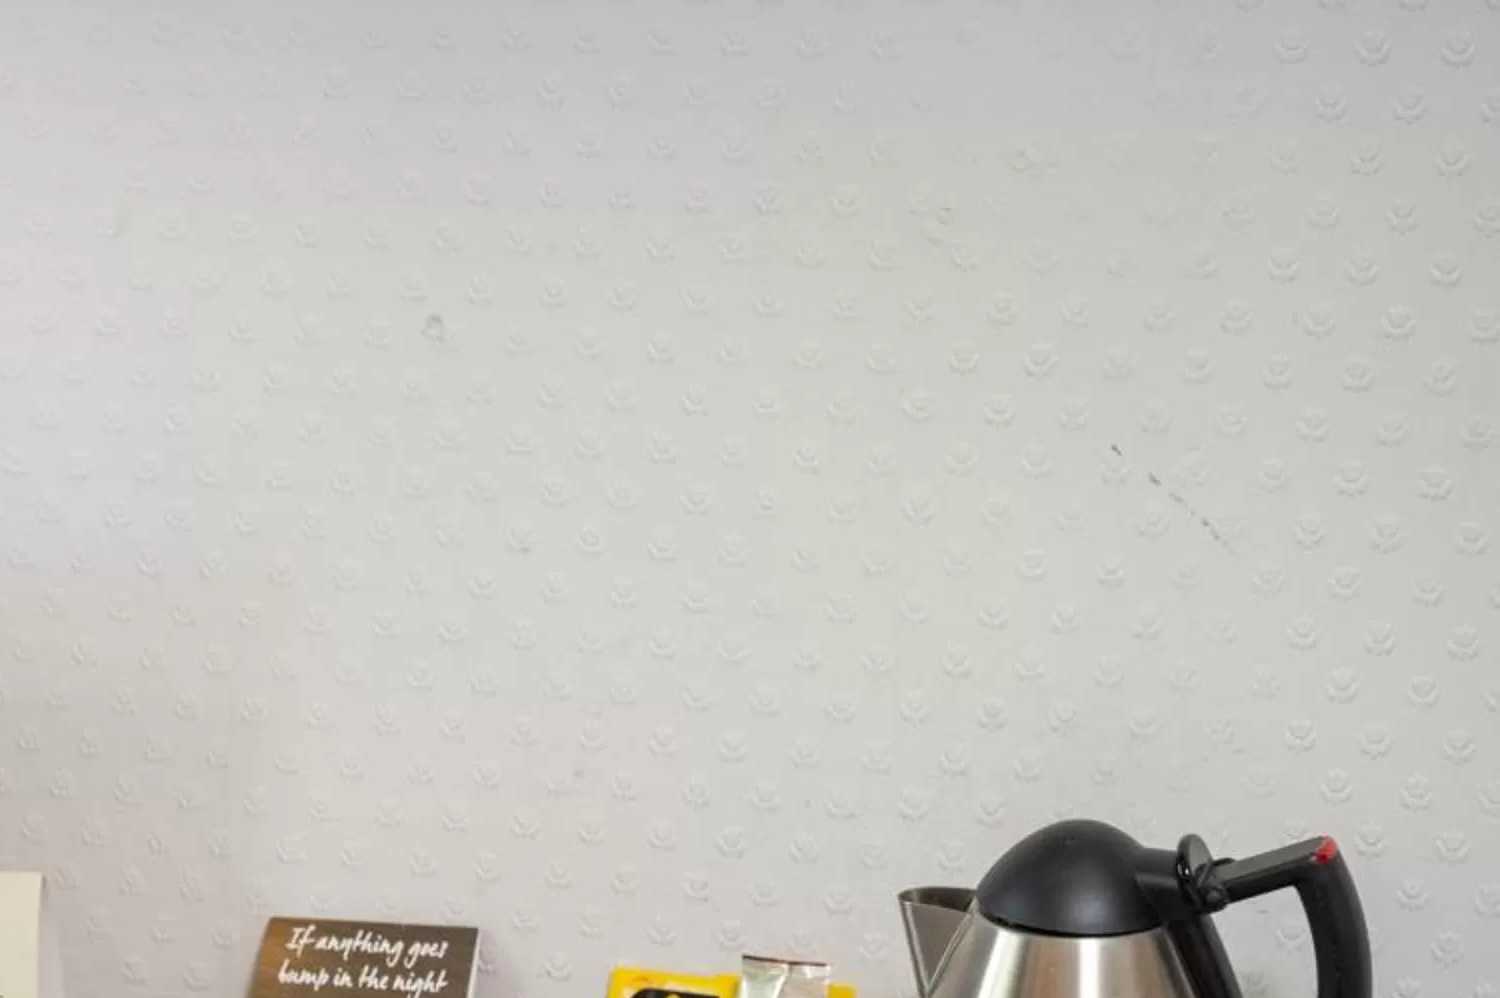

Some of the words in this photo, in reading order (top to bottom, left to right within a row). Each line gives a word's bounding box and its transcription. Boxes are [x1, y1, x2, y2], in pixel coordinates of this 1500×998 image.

[285, 923, 317, 959] If
[314, 929, 405, 968] anything
[404, 940, 449, 969] goes
[277, 958, 330, 993] bump
[332, 967, 353, 989] in
[358, 964, 390, 990] the
